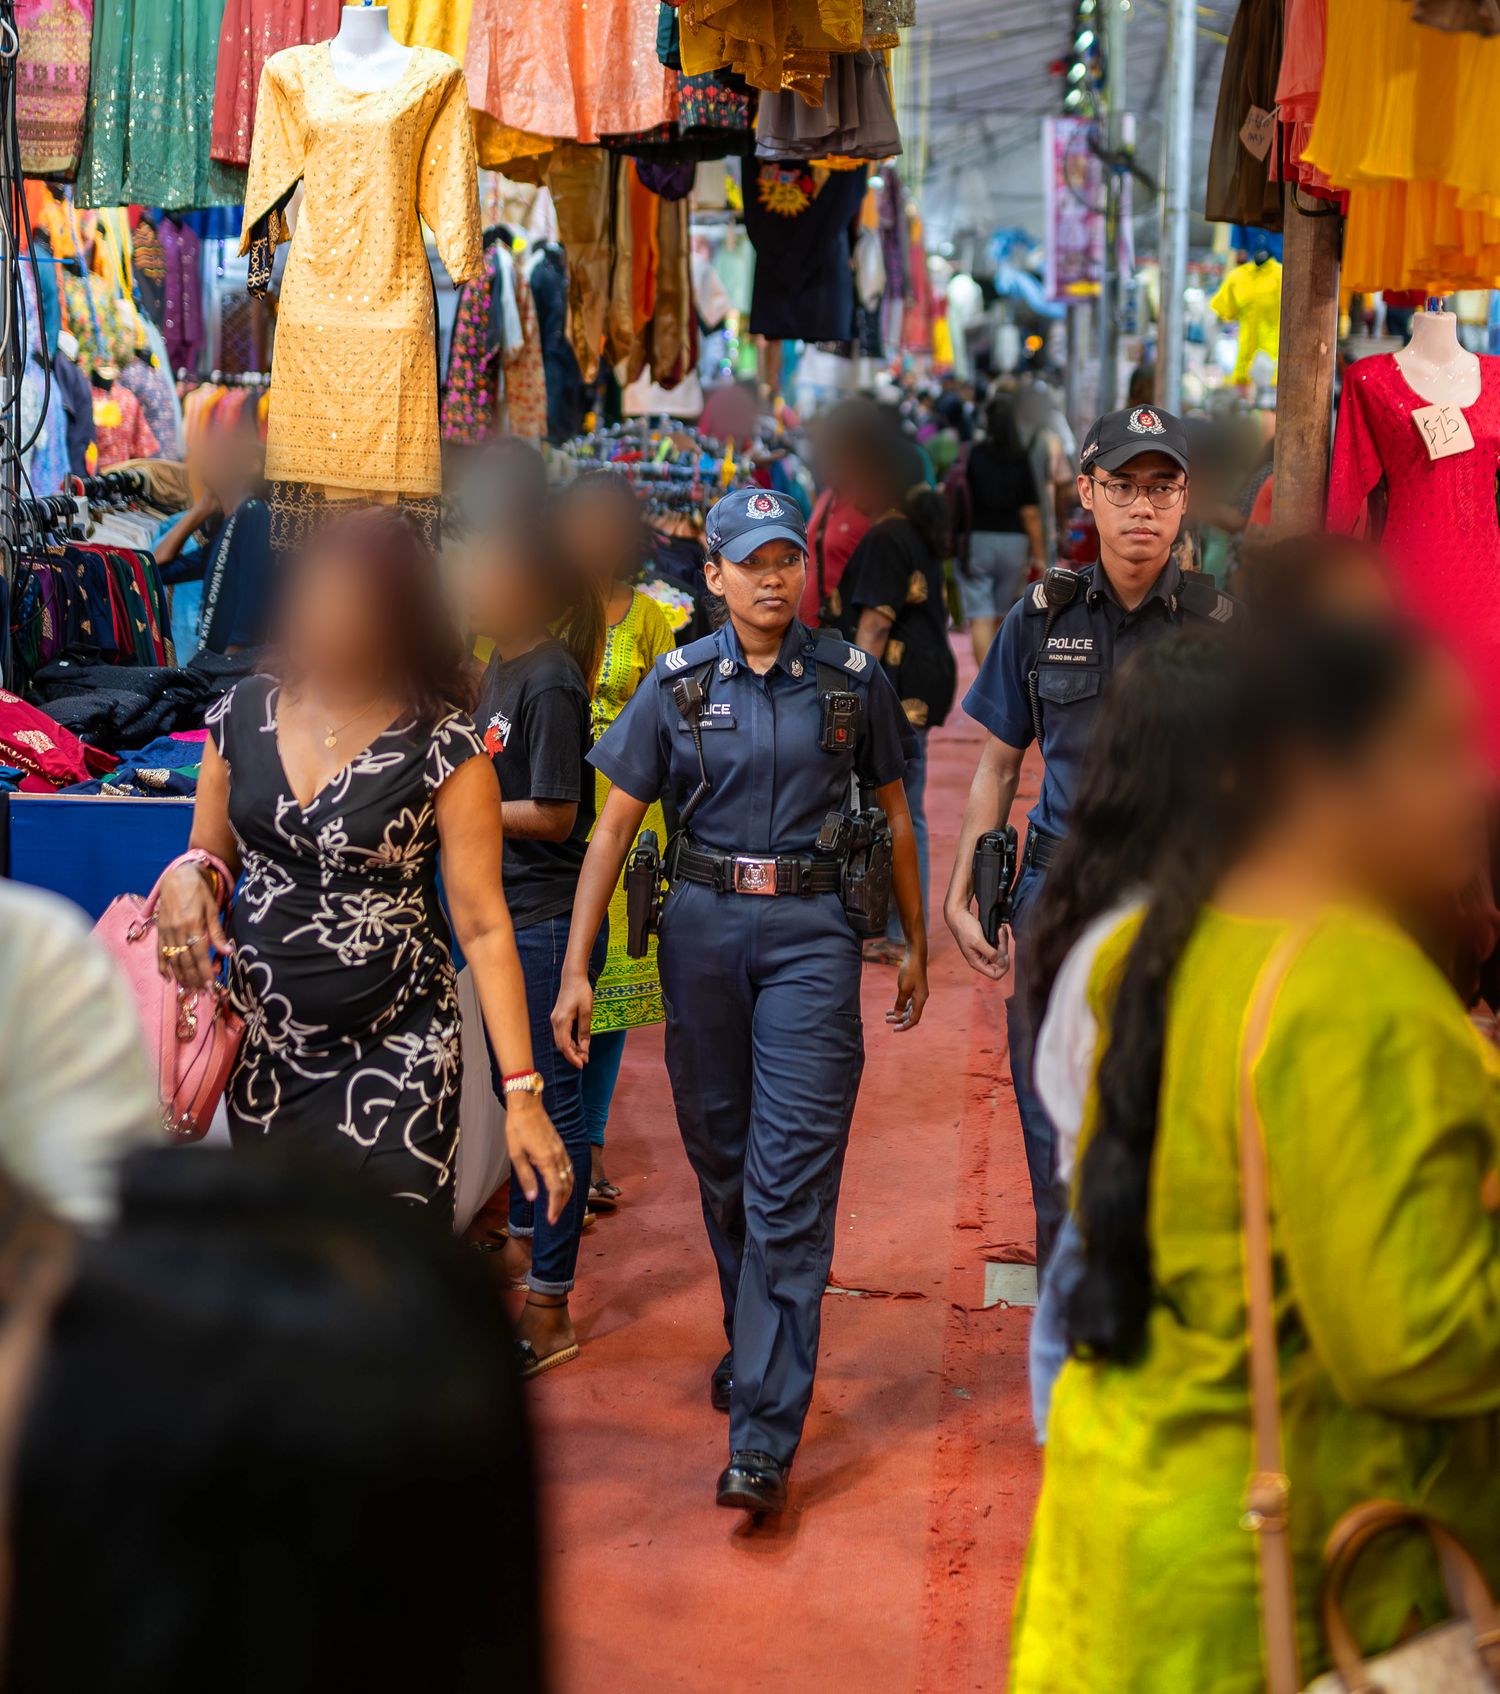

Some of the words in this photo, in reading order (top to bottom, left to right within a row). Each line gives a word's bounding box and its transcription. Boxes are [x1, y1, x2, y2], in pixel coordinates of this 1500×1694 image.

[1422, 406, 1460, 456] $15
[215, 538, 231, 571] YOUR
[208, 572, 223, 604] OWN
[1047, 637, 1093, 650] POLICE
[698, 703, 731, 716] LICE
